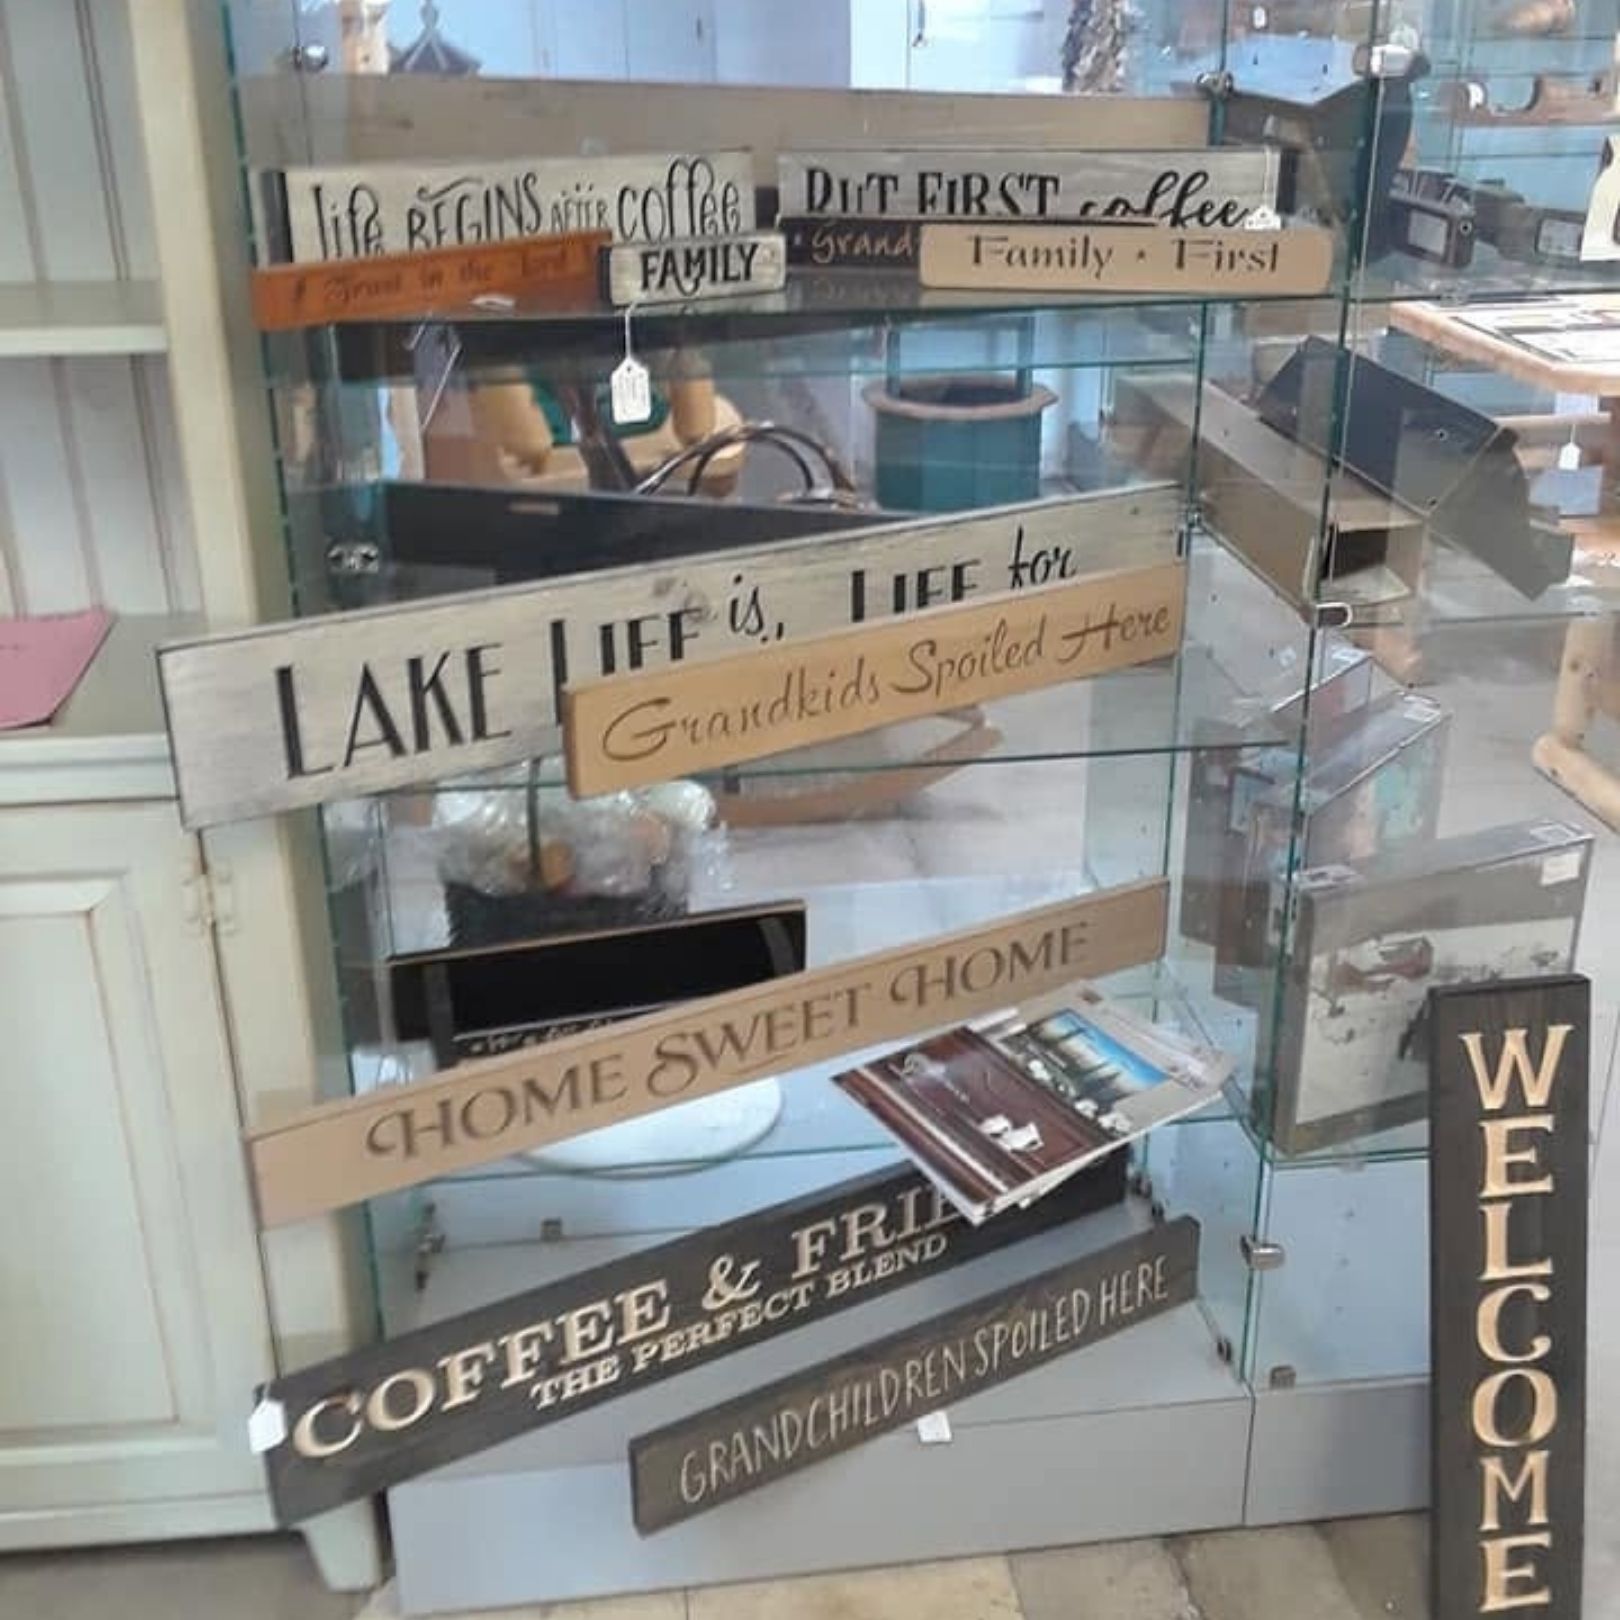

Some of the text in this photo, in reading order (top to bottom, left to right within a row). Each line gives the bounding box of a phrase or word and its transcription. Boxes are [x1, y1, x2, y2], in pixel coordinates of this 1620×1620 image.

[640, 242, 759, 297] FAMILY
[918, 171, 1060, 217] FIRST
[966, 234, 1279, 280] Family First
[274, 642, 512, 781] LAKE
[601, 602, 1170, 762] Grandkids Spoiled Here
[366, 919, 1095, 1158] HOME SWEET HOME
[292, 1278, 672, 1459] COFFEE
[701, 1252, 761, 1312] &
[529, 1232, 948, 1411] THE PERFECT BLEND
[680, 1254, 1170, 1504] GRANDCHILDREN SPOILED HERE
[1458, 1024, 1575, 1614] WELCOME
